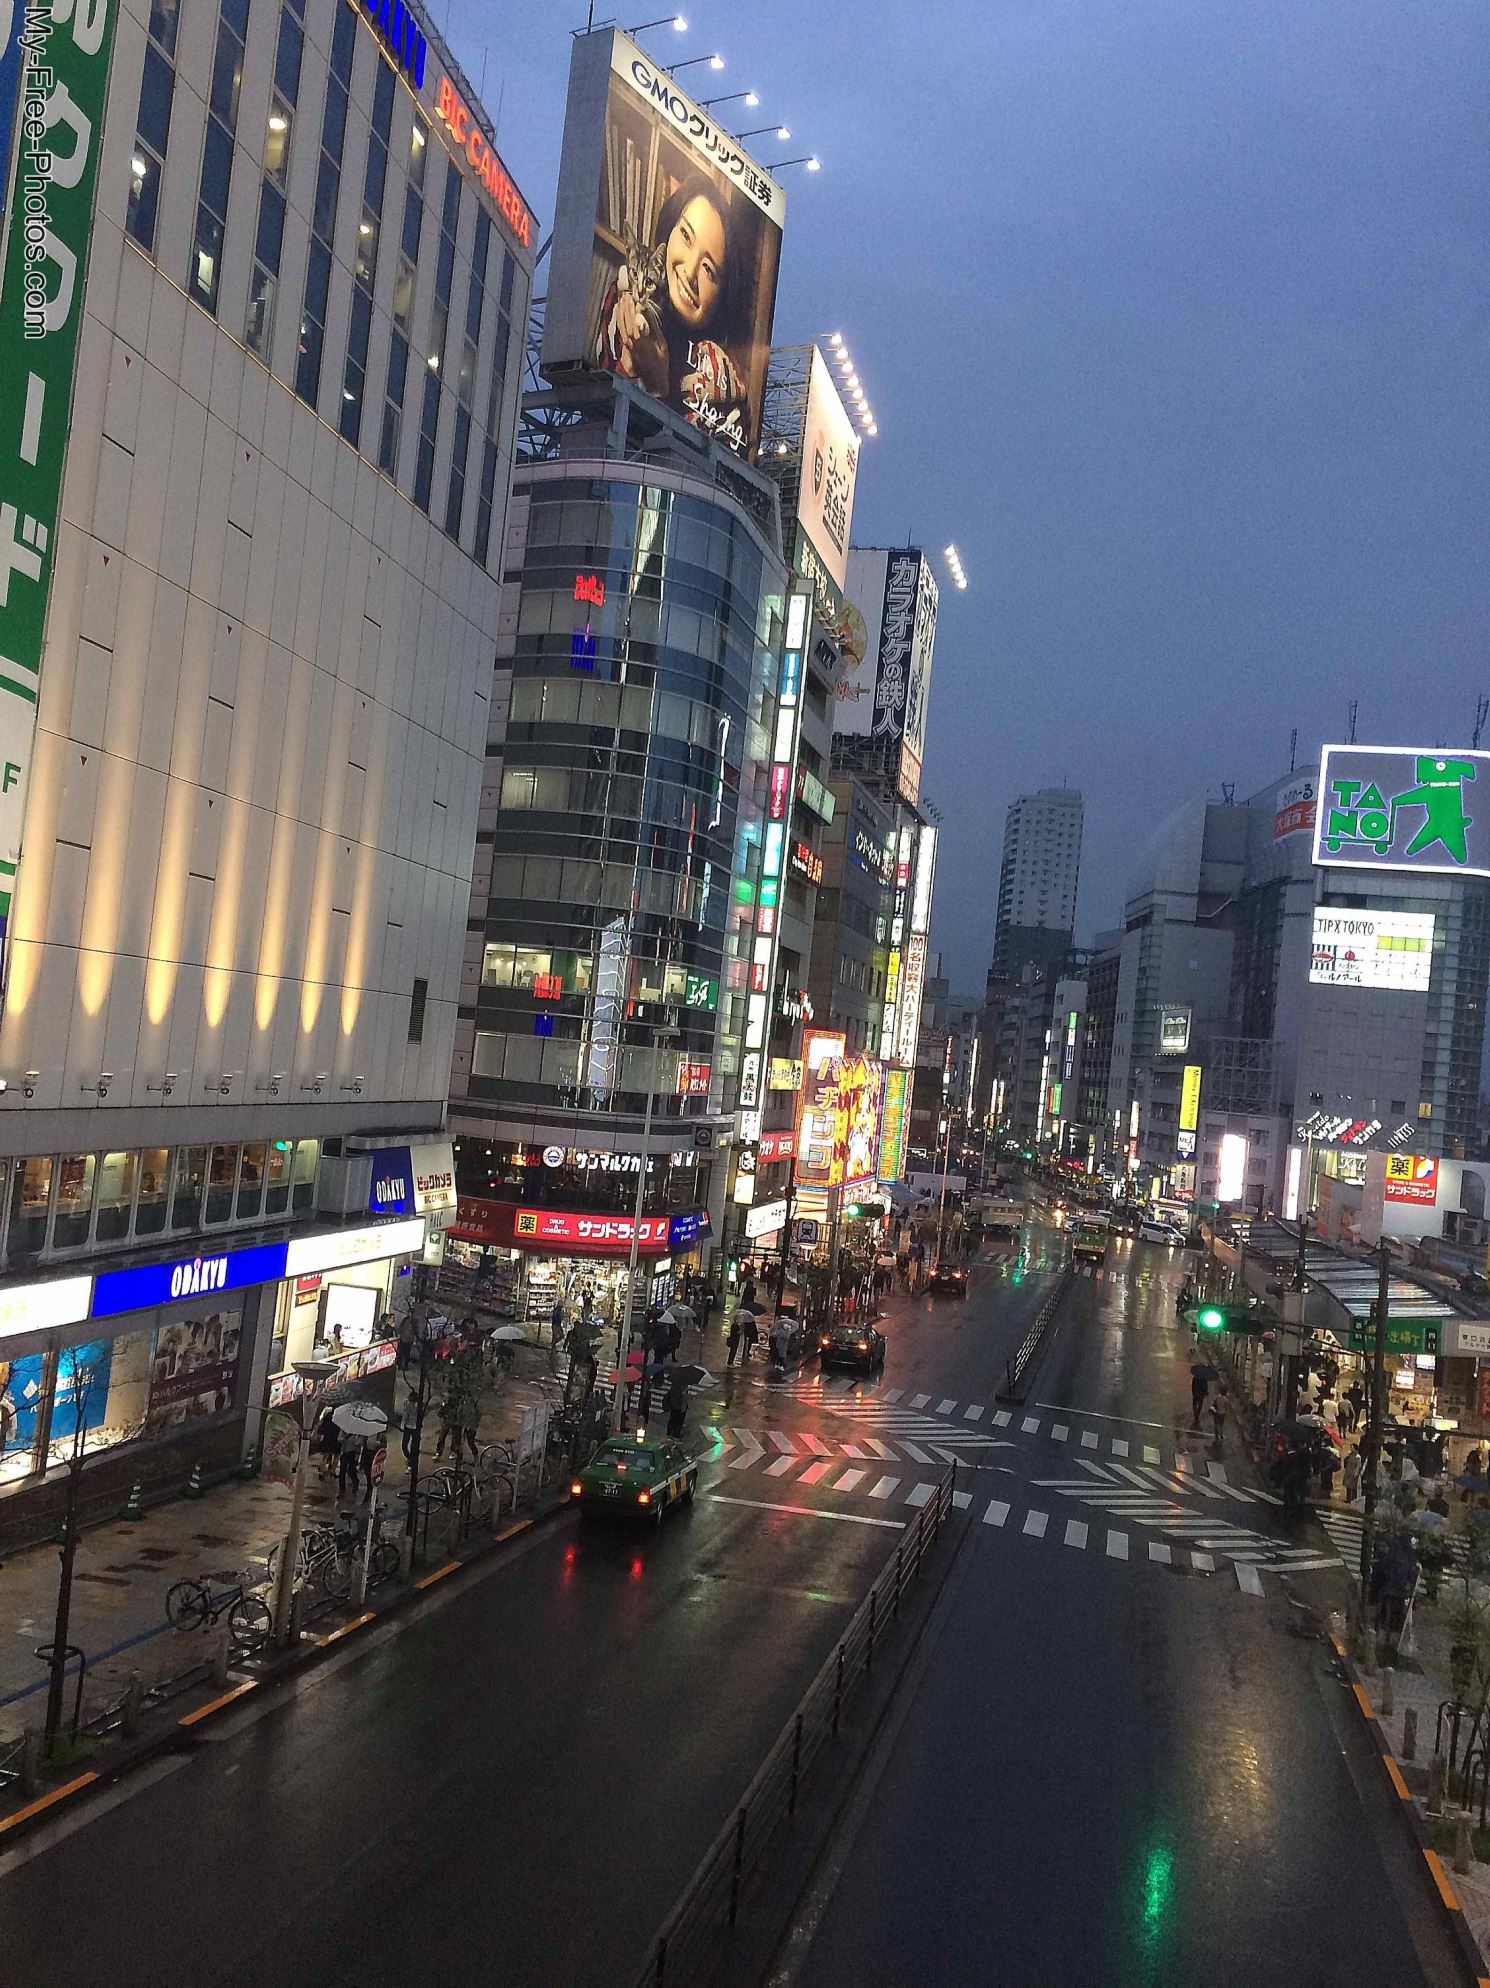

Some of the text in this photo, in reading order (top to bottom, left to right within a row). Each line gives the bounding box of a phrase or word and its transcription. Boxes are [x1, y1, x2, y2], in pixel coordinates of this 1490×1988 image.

[631, 60, 773, 207] GMOクリック証券
[438, 74, 531, 249] BIC CAMERA
[872, 556, 920, 740] カラオケの鉄人
[1332, 780, 1387, 809] TA
[1328, 810, 1390, 840] NO
[808, 1055, 843, 1170] パチンコ
[1391, 1157, 1410, 1176] 薬
[376, 1177, 406, 1203] ODAKYU
[416, 1172, 452, 1192] ビックカメラ
[458, 1203, 488, 1219] くすり
[519, 1215, 536, 1232] 薬
[170, 1257, 229, 1298] ODAKYU
